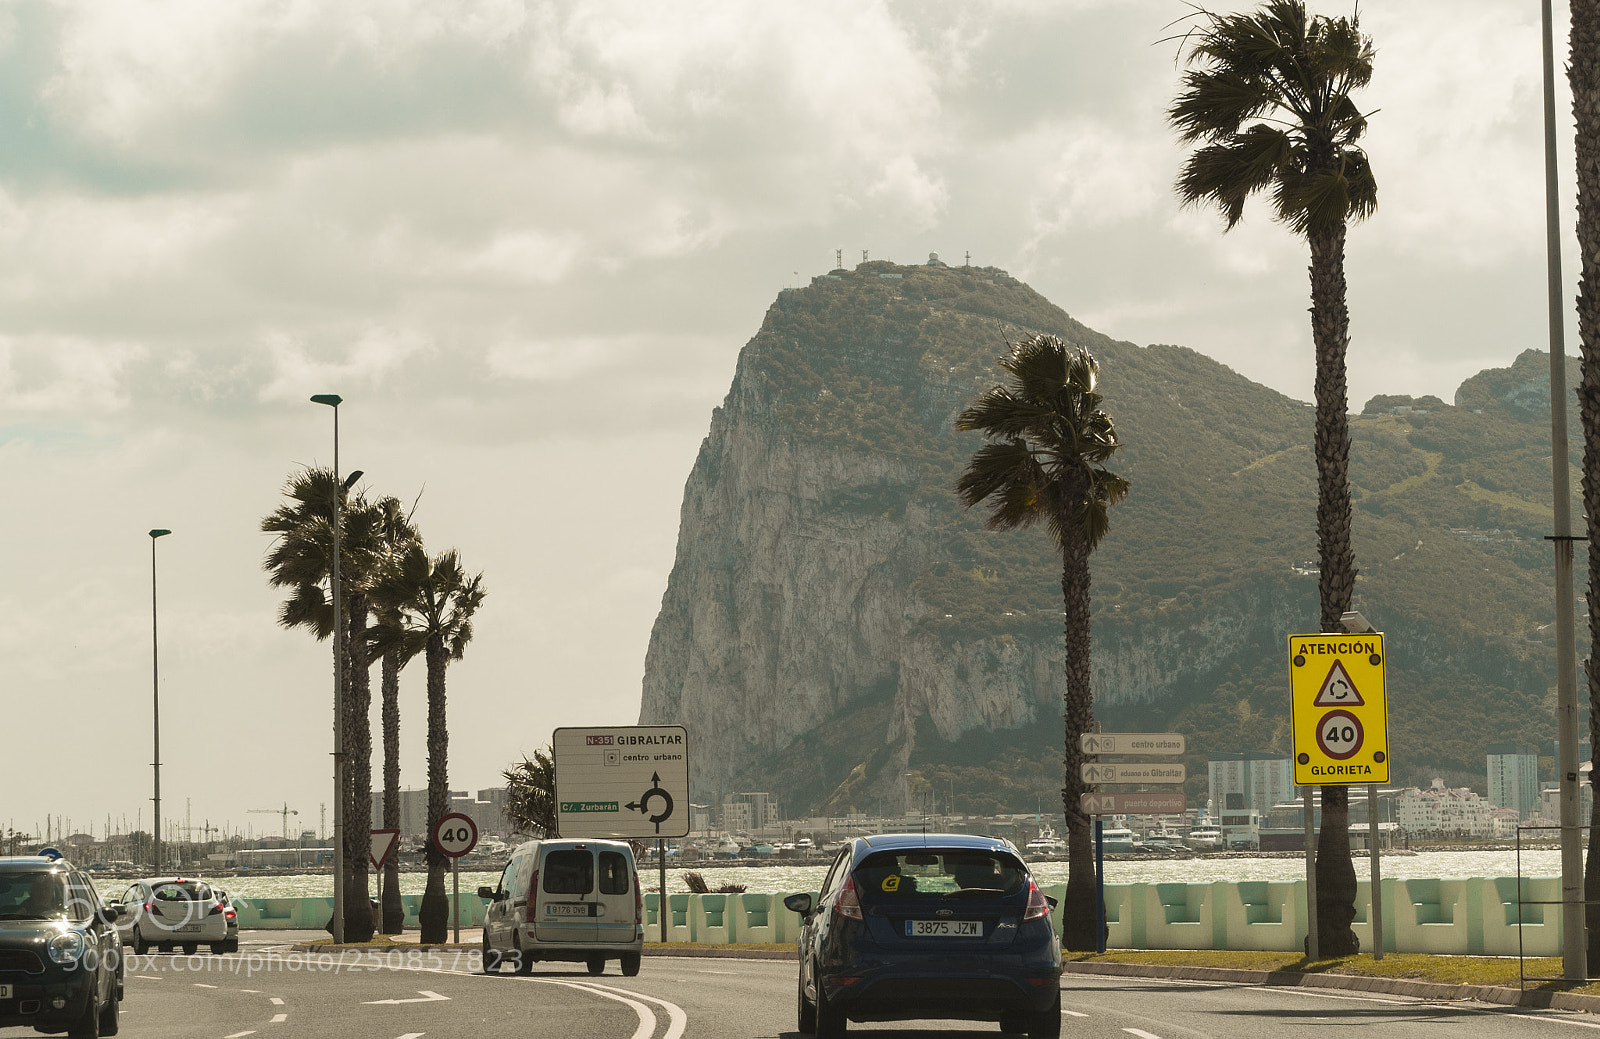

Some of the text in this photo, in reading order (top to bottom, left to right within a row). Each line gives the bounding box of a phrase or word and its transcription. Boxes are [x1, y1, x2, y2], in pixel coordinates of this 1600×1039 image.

[1299, 640, 1375, 654] ATENCIÓN
[587, 735, 682, 745] N-351 GIBRALTAR
[1325, 726, 1355, 743] 40
[1131, 740, 1181, 749] centro urbano
[654, 753, 682, 761] urbano
[1151, 769, 1182, 777] Gibraltar
[1311, 765, 1372, 776] GLORIETA
[442, 828, 469, 843] 40
[917, 922, 977, 935] 3875 JZW
